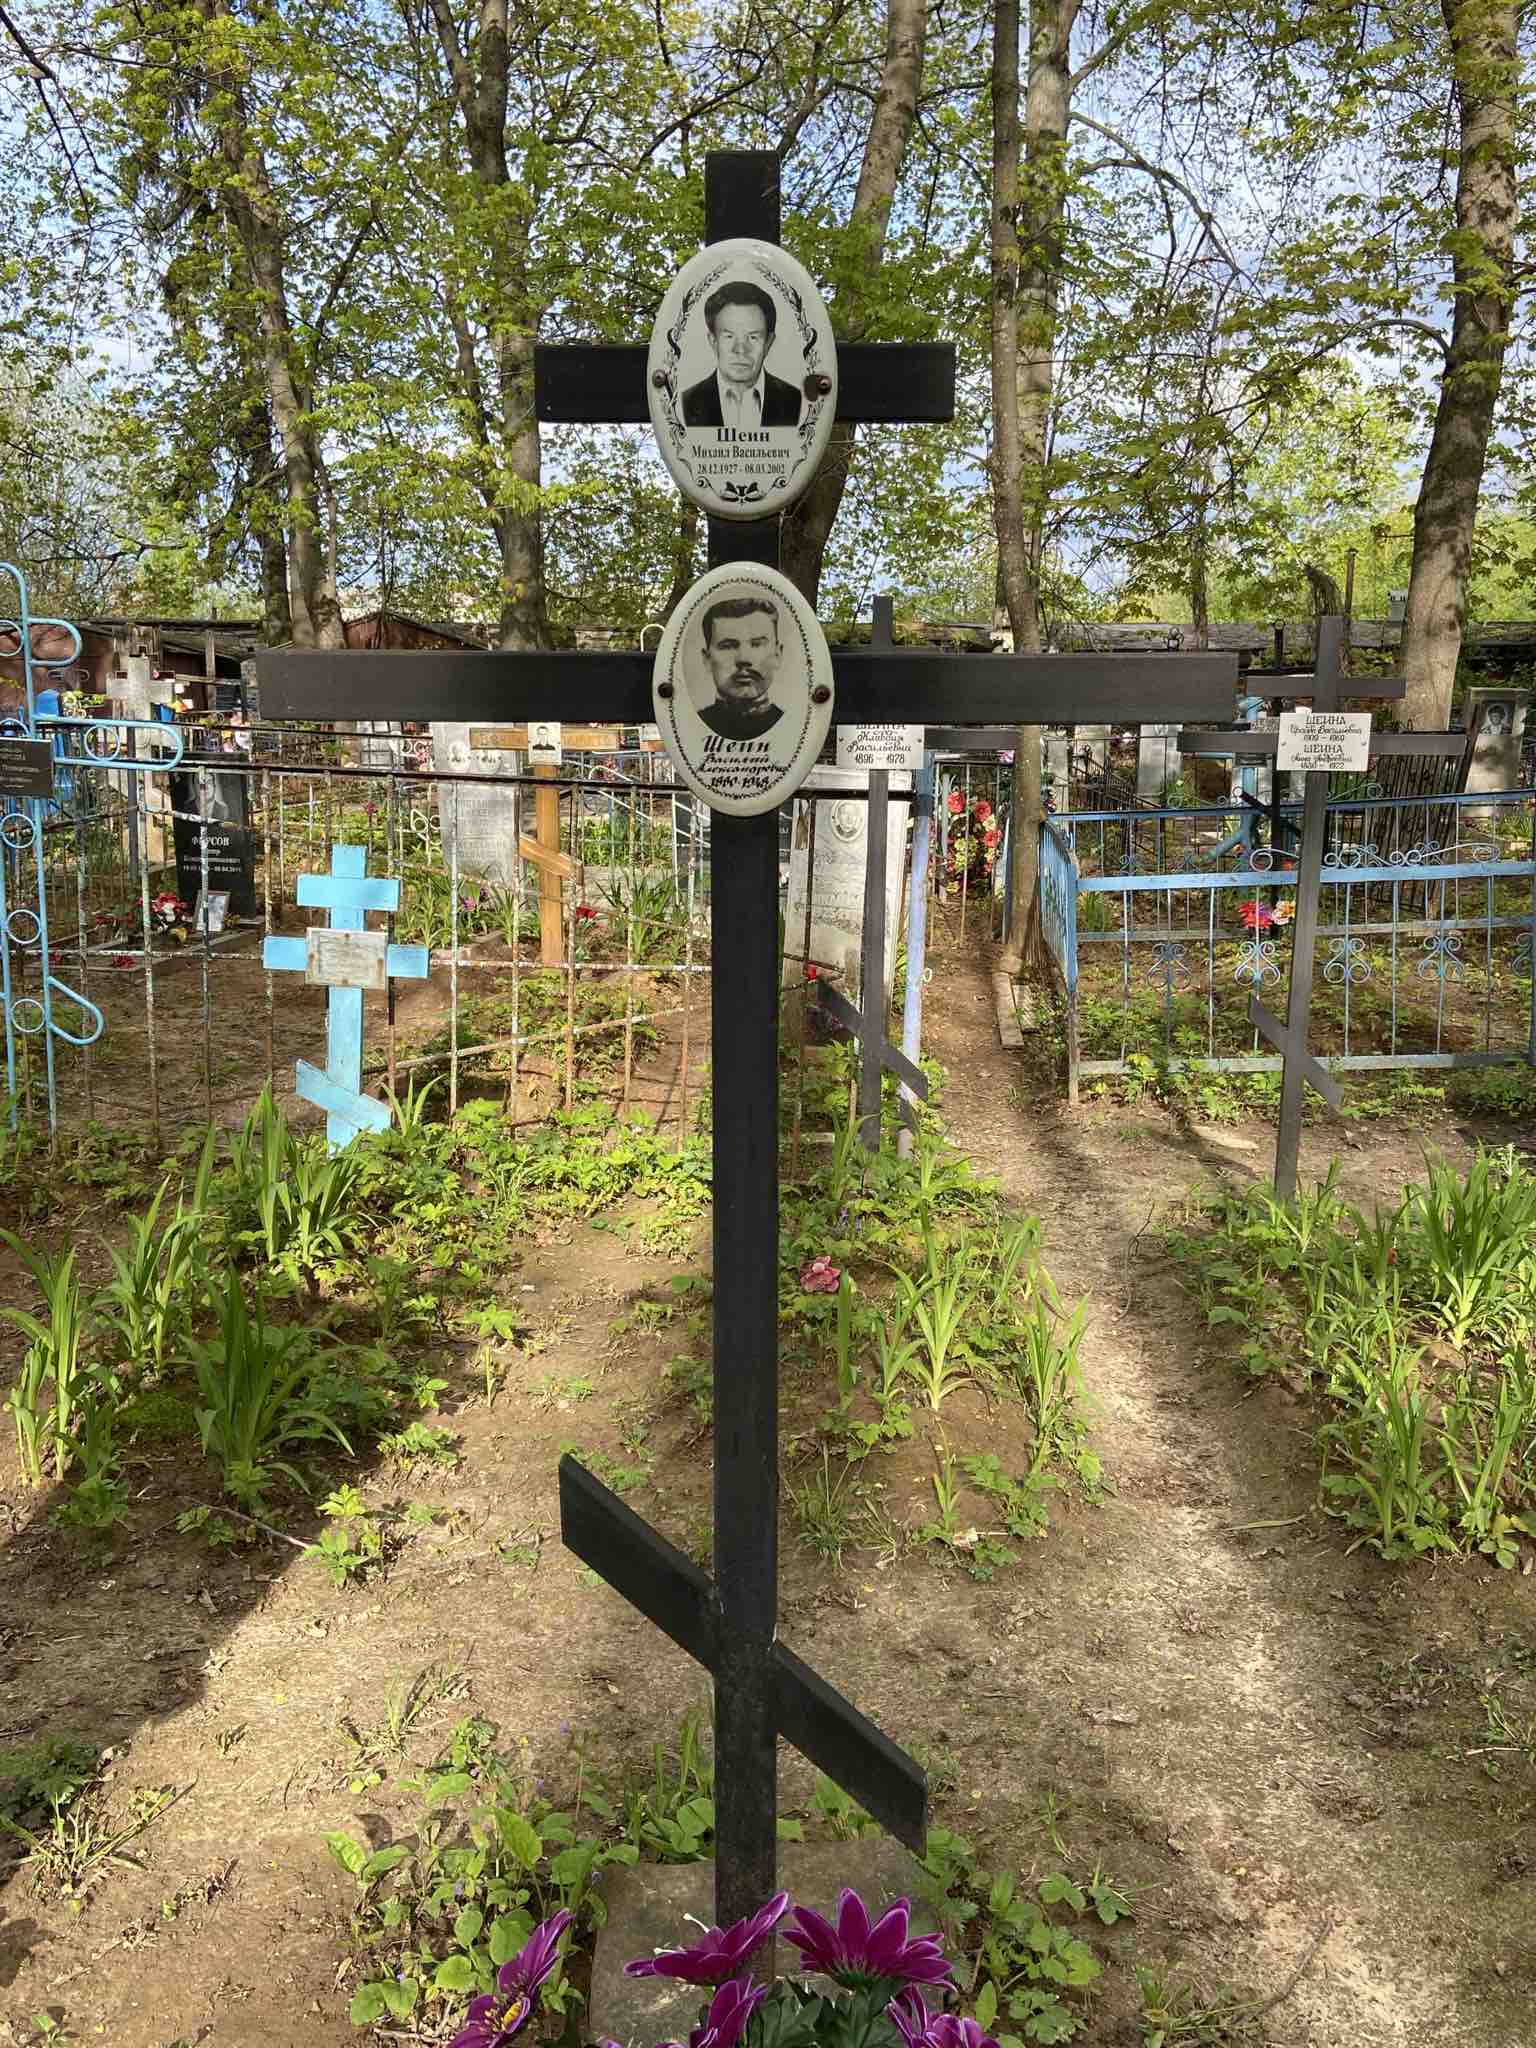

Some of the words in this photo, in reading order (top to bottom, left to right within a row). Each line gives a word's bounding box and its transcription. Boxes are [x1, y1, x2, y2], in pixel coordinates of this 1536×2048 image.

[717, 428, 770, 442] Шеин
[692, 446, 730, 458] Михаил
[733, 446, 790, 458] Васильевич
[1305, 715, 1346, 725] ШЕИНА
[703, 736, 769, 752] Шеин
[1304, 744, 1343, 753] ШЕИНА
[886, 753, 905, 764] 1978
[191, 835, 230, 847] ФСОВ
